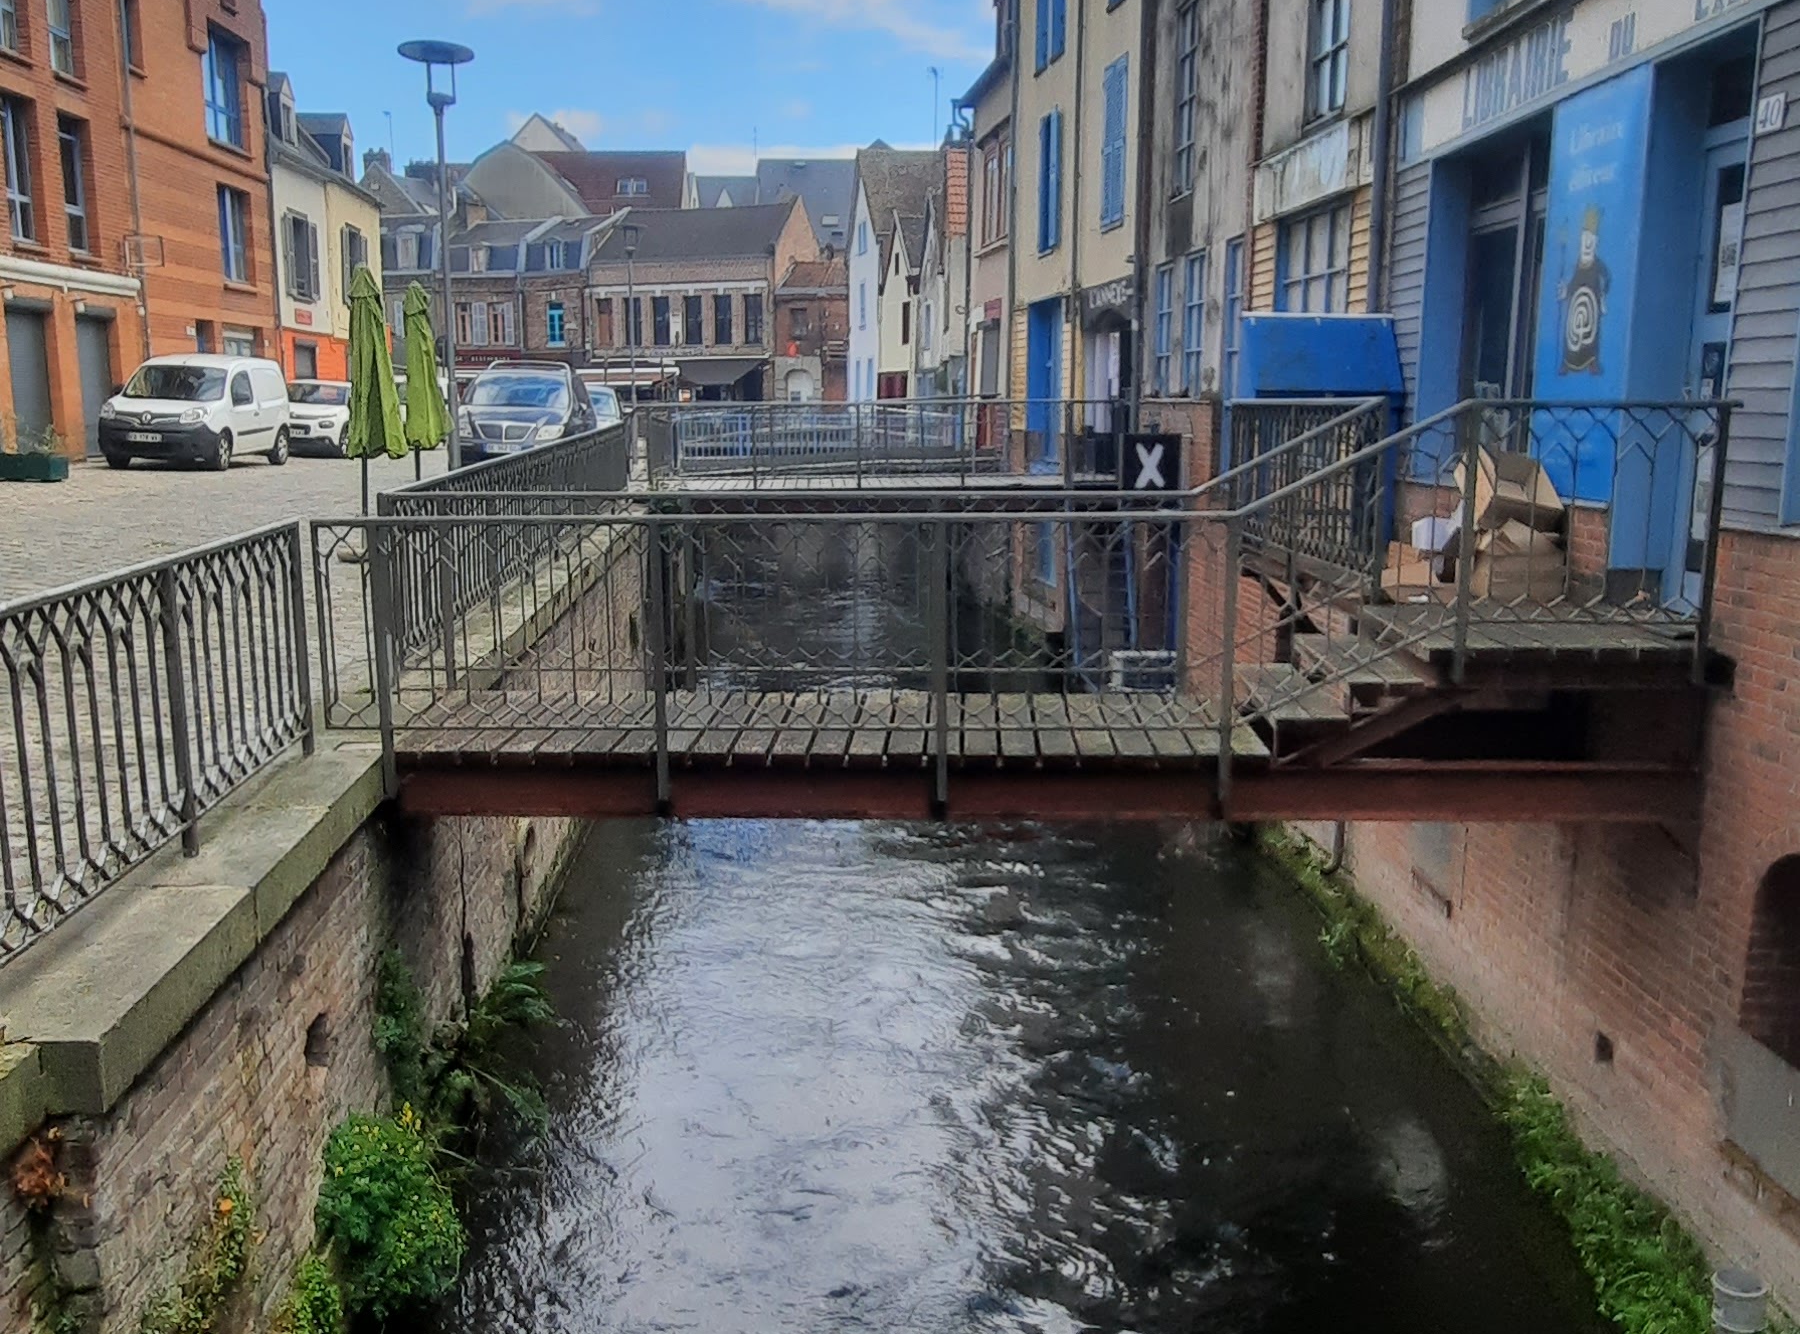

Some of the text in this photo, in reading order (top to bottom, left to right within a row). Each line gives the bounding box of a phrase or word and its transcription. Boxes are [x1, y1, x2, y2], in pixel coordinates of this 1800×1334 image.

[1461, 9, 1572, 131] LIBRAIRIE
[1608, 11, 1637, 62] DU
[1758, 97, 1781, 129] 40
[1133, 441, 1167, 490] X
